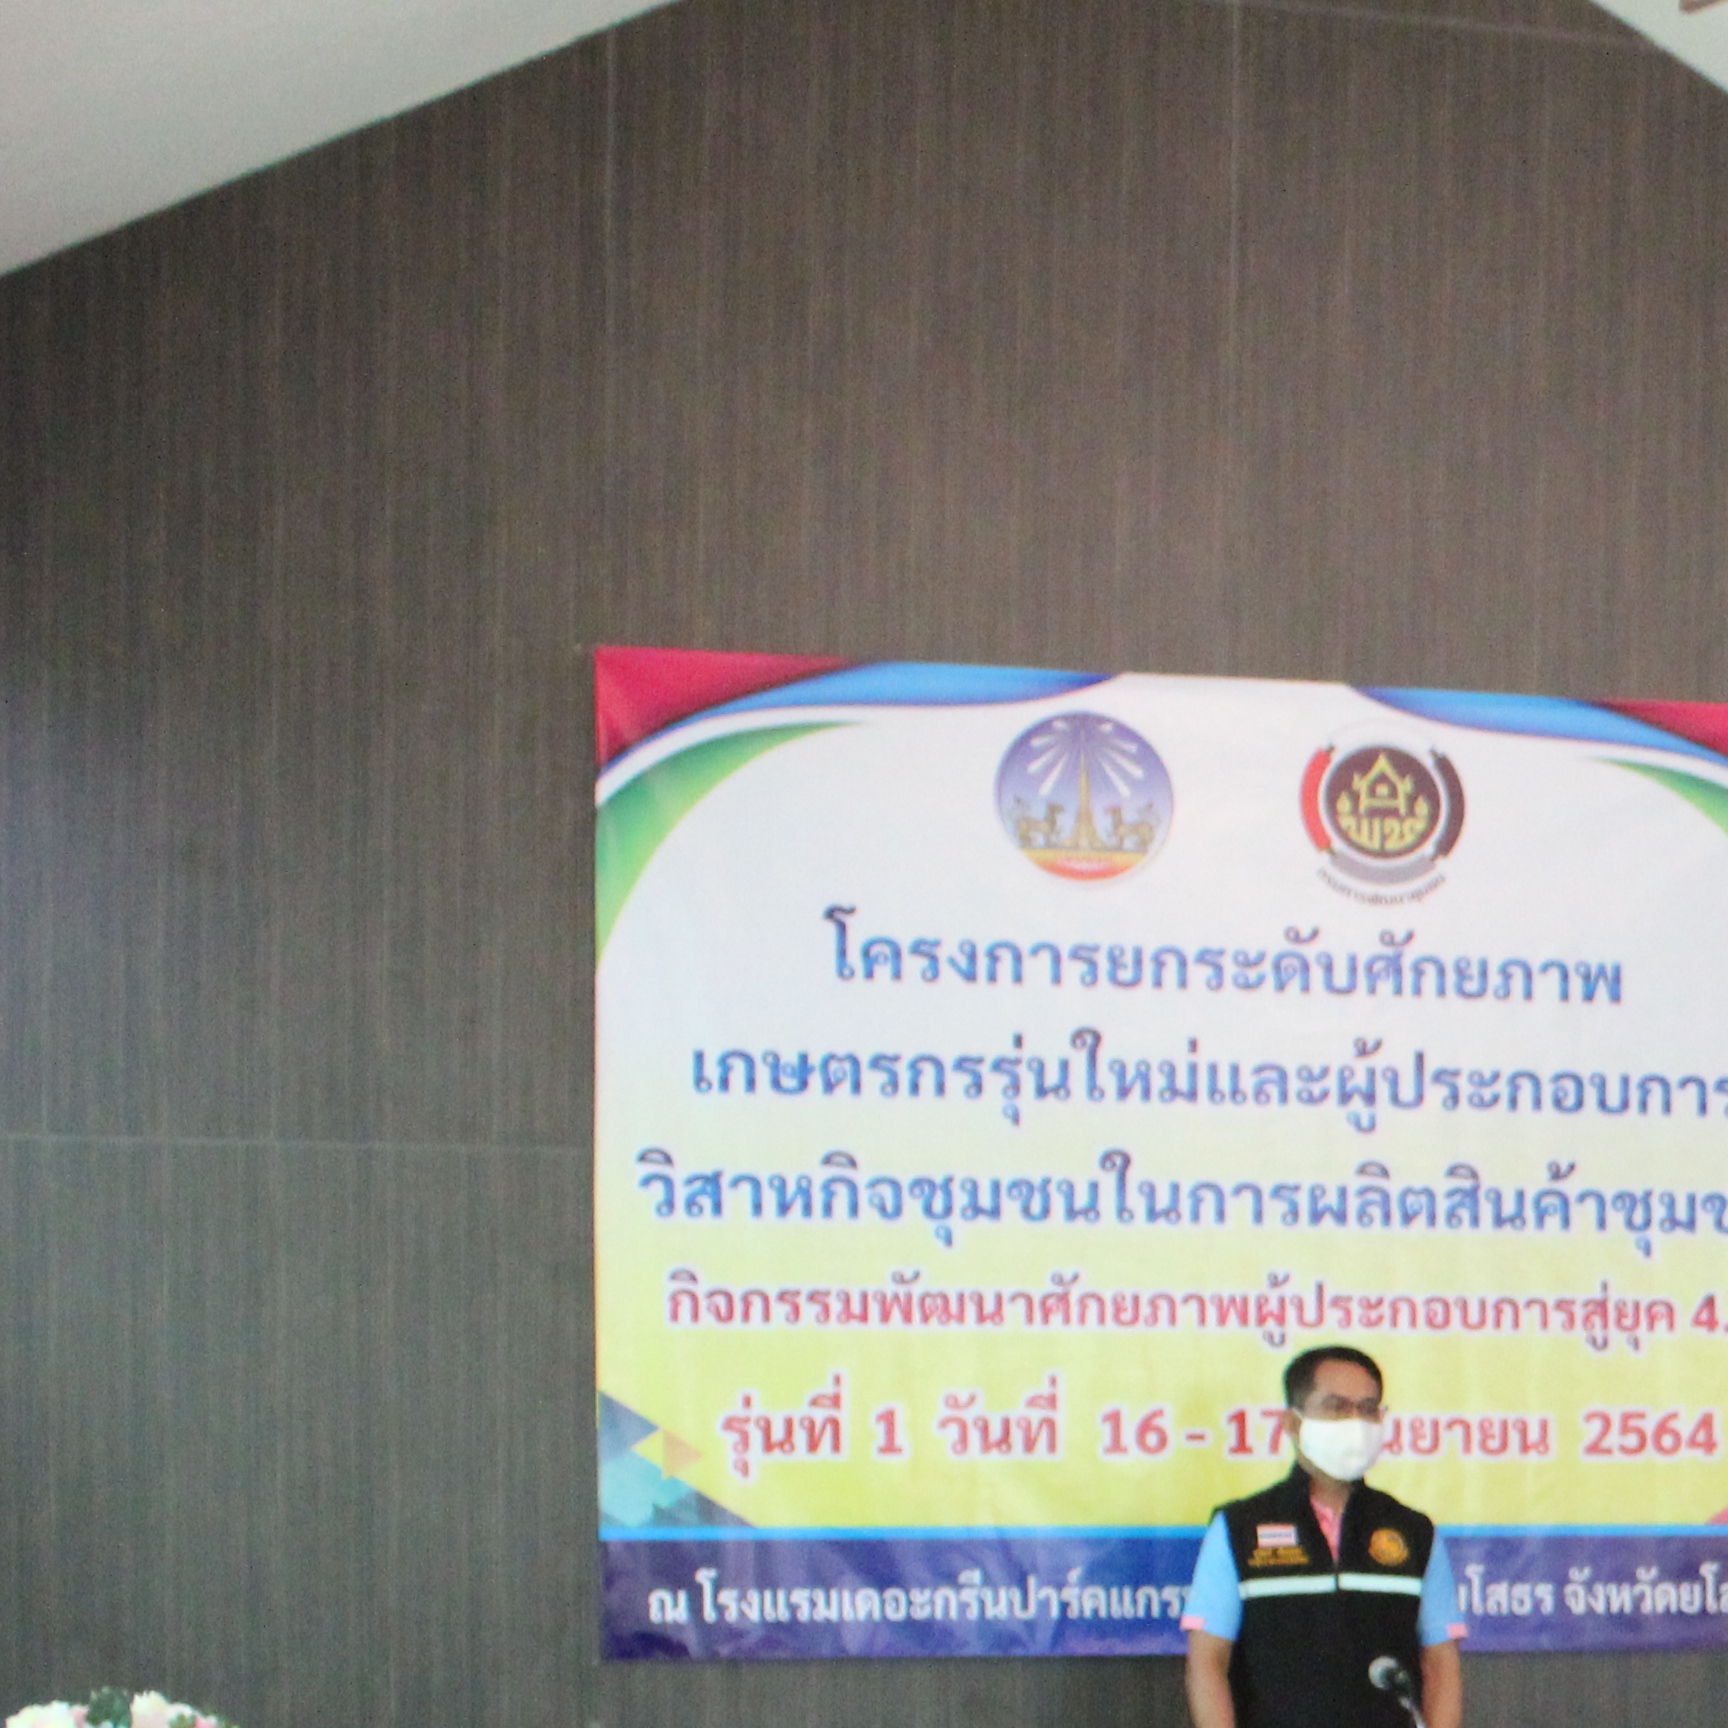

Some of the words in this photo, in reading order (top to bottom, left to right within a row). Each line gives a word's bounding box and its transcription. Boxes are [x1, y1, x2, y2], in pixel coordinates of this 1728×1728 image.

[823, 904, 1623, 1004] โครงการยกระดับศักยภาพ
[668, 1268, 1675, 1351] กิจกรรมพัฒนาศักยภาพผู้ประกอบการสู่ยุค
[722, 1374, 842, 1478] รุ่นที่
[876, 1409, 903, 1455] 1
[939, 1375, 1058, 1455] วันที่
[1101, 1409, 1169, 1455] 16
[1227, 1409, 1287, 1455] 17
[1382, 1413, 1550, 1456] นยายน
[1584, 1411, 1718, 1456] 2564
[647, 1587, 688, 1624] ณ
[694, 1568, 1194, 1624] โรงแรมเดอะกรีนปาร์คแกร
[1457, 1562, 1555, 1616] โสธร
